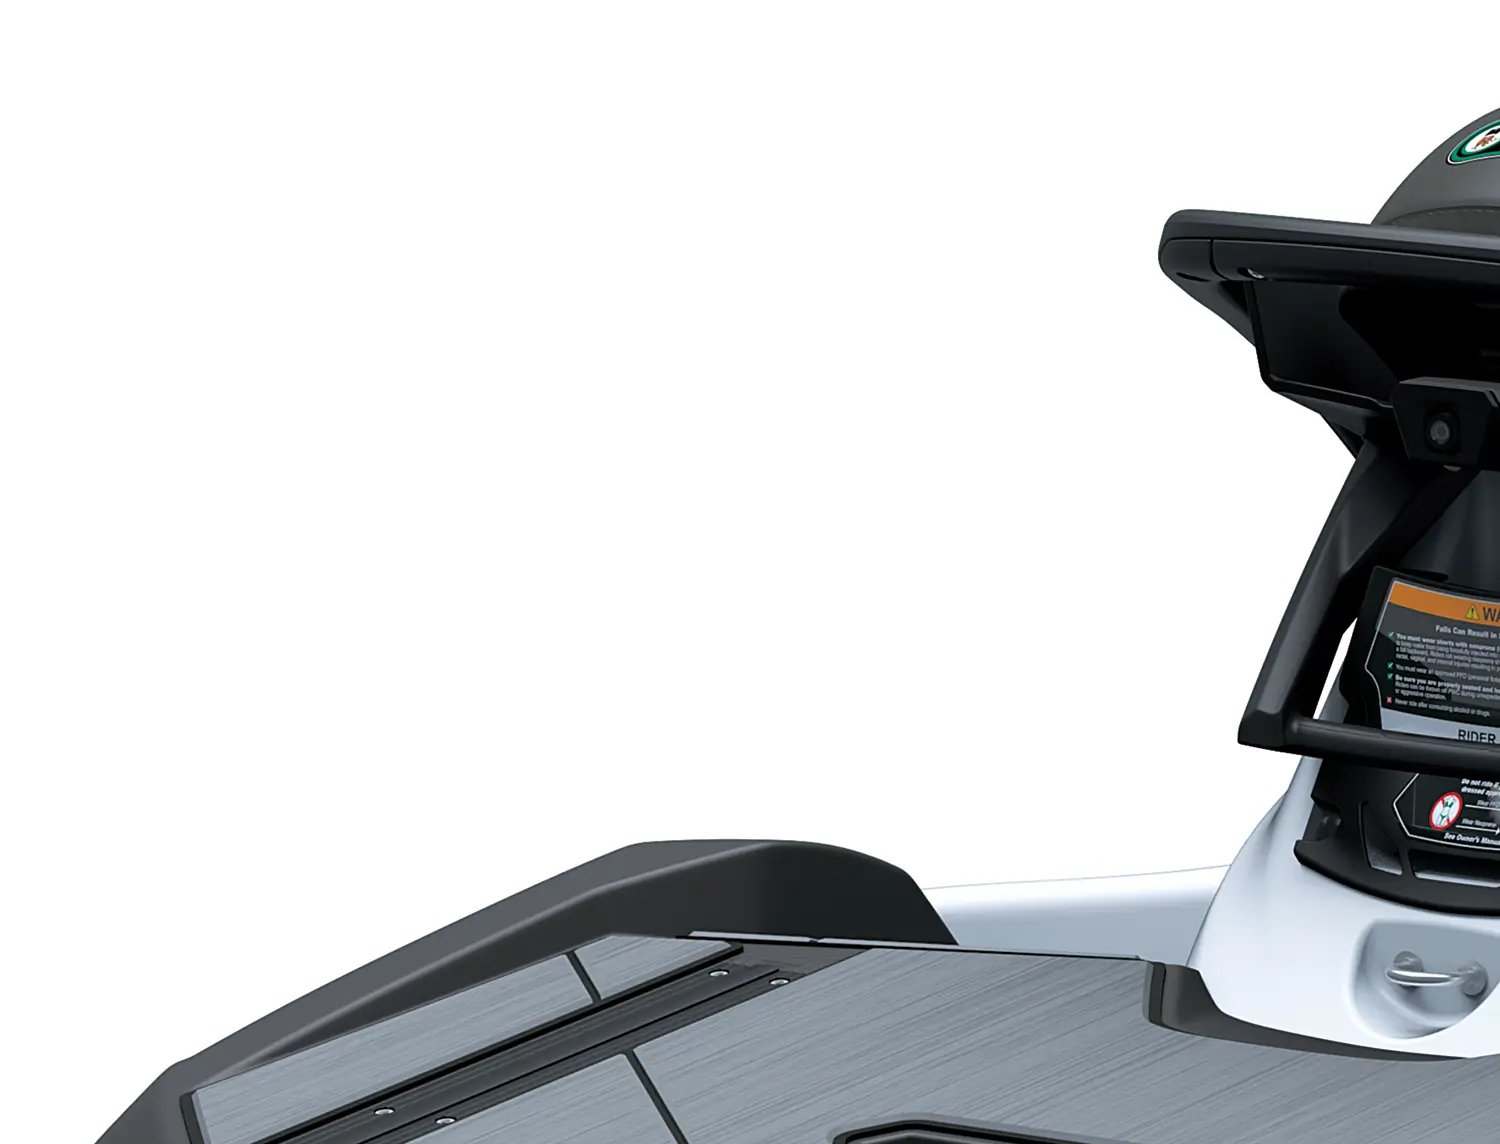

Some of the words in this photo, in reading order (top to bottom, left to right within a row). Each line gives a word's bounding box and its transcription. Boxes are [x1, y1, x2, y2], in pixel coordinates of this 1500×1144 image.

[1436, 625, 1452, 634] Falls
[1453, 627, 1466, 635] Can
[1467, 628, 1489, 638] Result
[1457, 729, 1496, 746] RIDER
[1482, 780, 1494, 788] ride
[1443, 832, 1456, 841] See
[1456, 833, 1480, 844] Owner's
